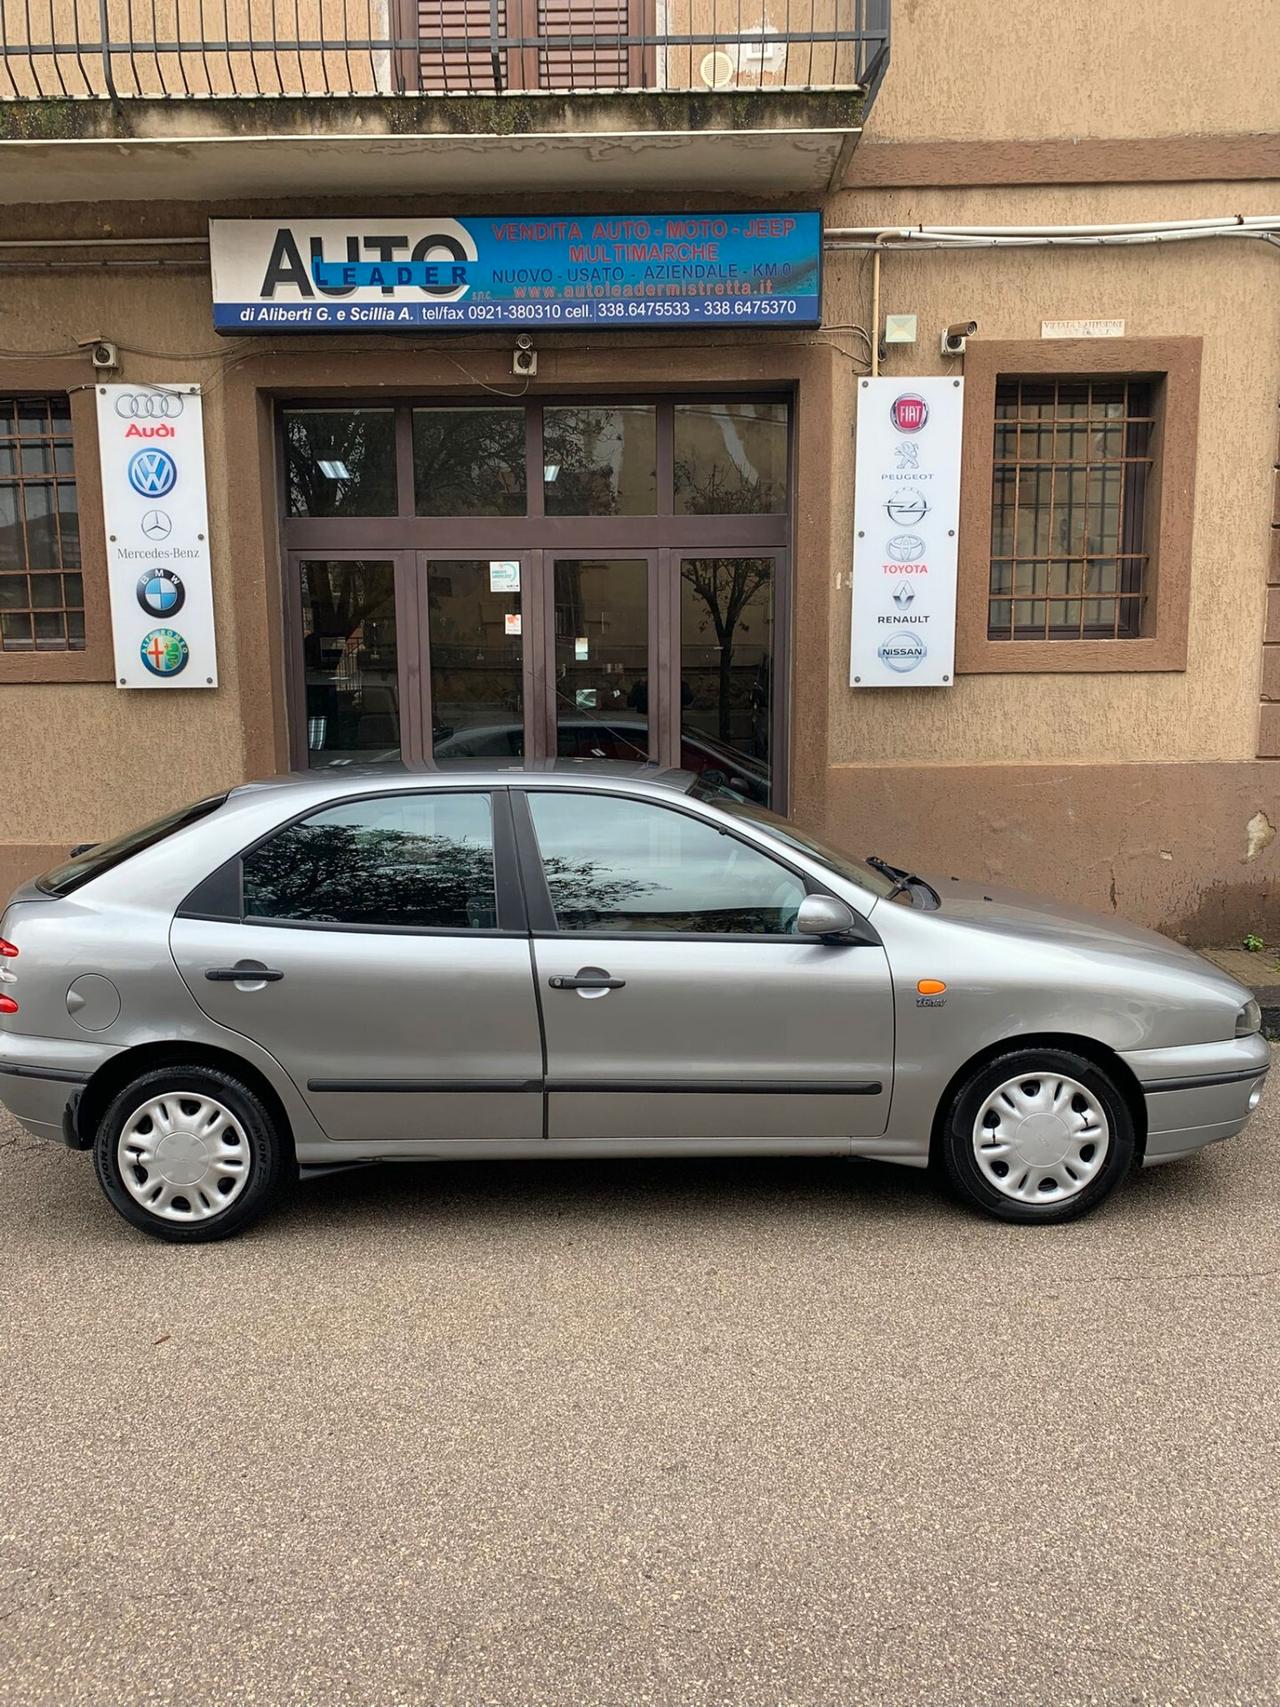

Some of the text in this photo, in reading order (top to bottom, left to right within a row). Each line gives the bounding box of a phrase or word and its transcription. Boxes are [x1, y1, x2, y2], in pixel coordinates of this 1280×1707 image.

[491, 223, 583, 241] VENDITA
[592, 222, 649, 240] AUTO
[666, 220, 727, 239] MOTO
[743, 219, 796, 238] JEEP
[569, 243, 720, 263] MULTIMARCHE
[260, 228, 469, 298] AUTO
[315, 258, 470, 286] LEADER
[492, 269, 553, 284] NUOVO
[567, 267, 625, 282] USATO
[644, 265, 738, 280] AZIENDALE
[753, 264, 778, 277] KM
[513, 281, 774, 299] www.autoleadermistretta.it
[240, 307, 254, 321] di
[258, 306, 312, 321] Aliberti
[316, 308, 332, 321] G.
[336, 311, 346, 321] e
[350, 307, 395, 321] Scillia
[398, 308, 414, 321] A.
[422, 306, 464, 320] tel/fax
[468, 306, 561, 319] 0921-380310
[565, 304, 593, 319] cell.
[598, 302, 690, 317] 338.6475533
[704, 301, 796, 316] 338.6475370
[900, 405, 922, 423] FIAT
[125, 423, 175, 438] Audi
[117, 547, 200, 559] Mercedes-Benz
[139, 568, 181, 585] BMW
[882, 564, 928, 575] TOYOTA
[877, 615, 930, 624] RENAULT
[882, 647, 923, 656] NISSAN
